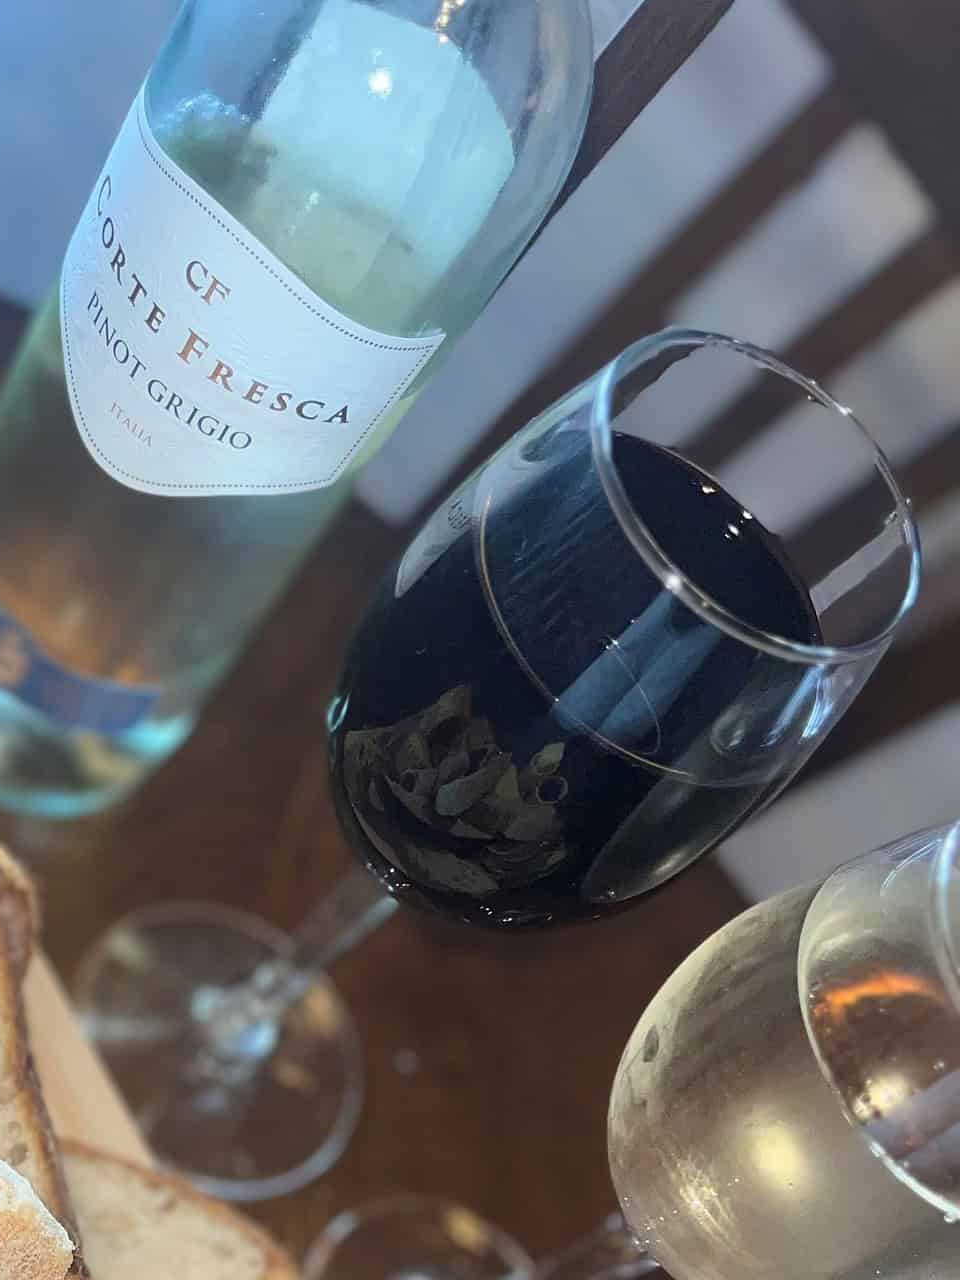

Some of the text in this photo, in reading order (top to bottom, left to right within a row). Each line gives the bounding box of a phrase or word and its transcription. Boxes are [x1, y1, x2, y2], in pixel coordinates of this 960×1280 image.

[96, 175, 351, 425] CORTE FRESCA
[185, 259, 232, 306] CF
[86, 289, 253, 451] PINOT GRIGIO
[109, 400, 152, 448] ITALIA
